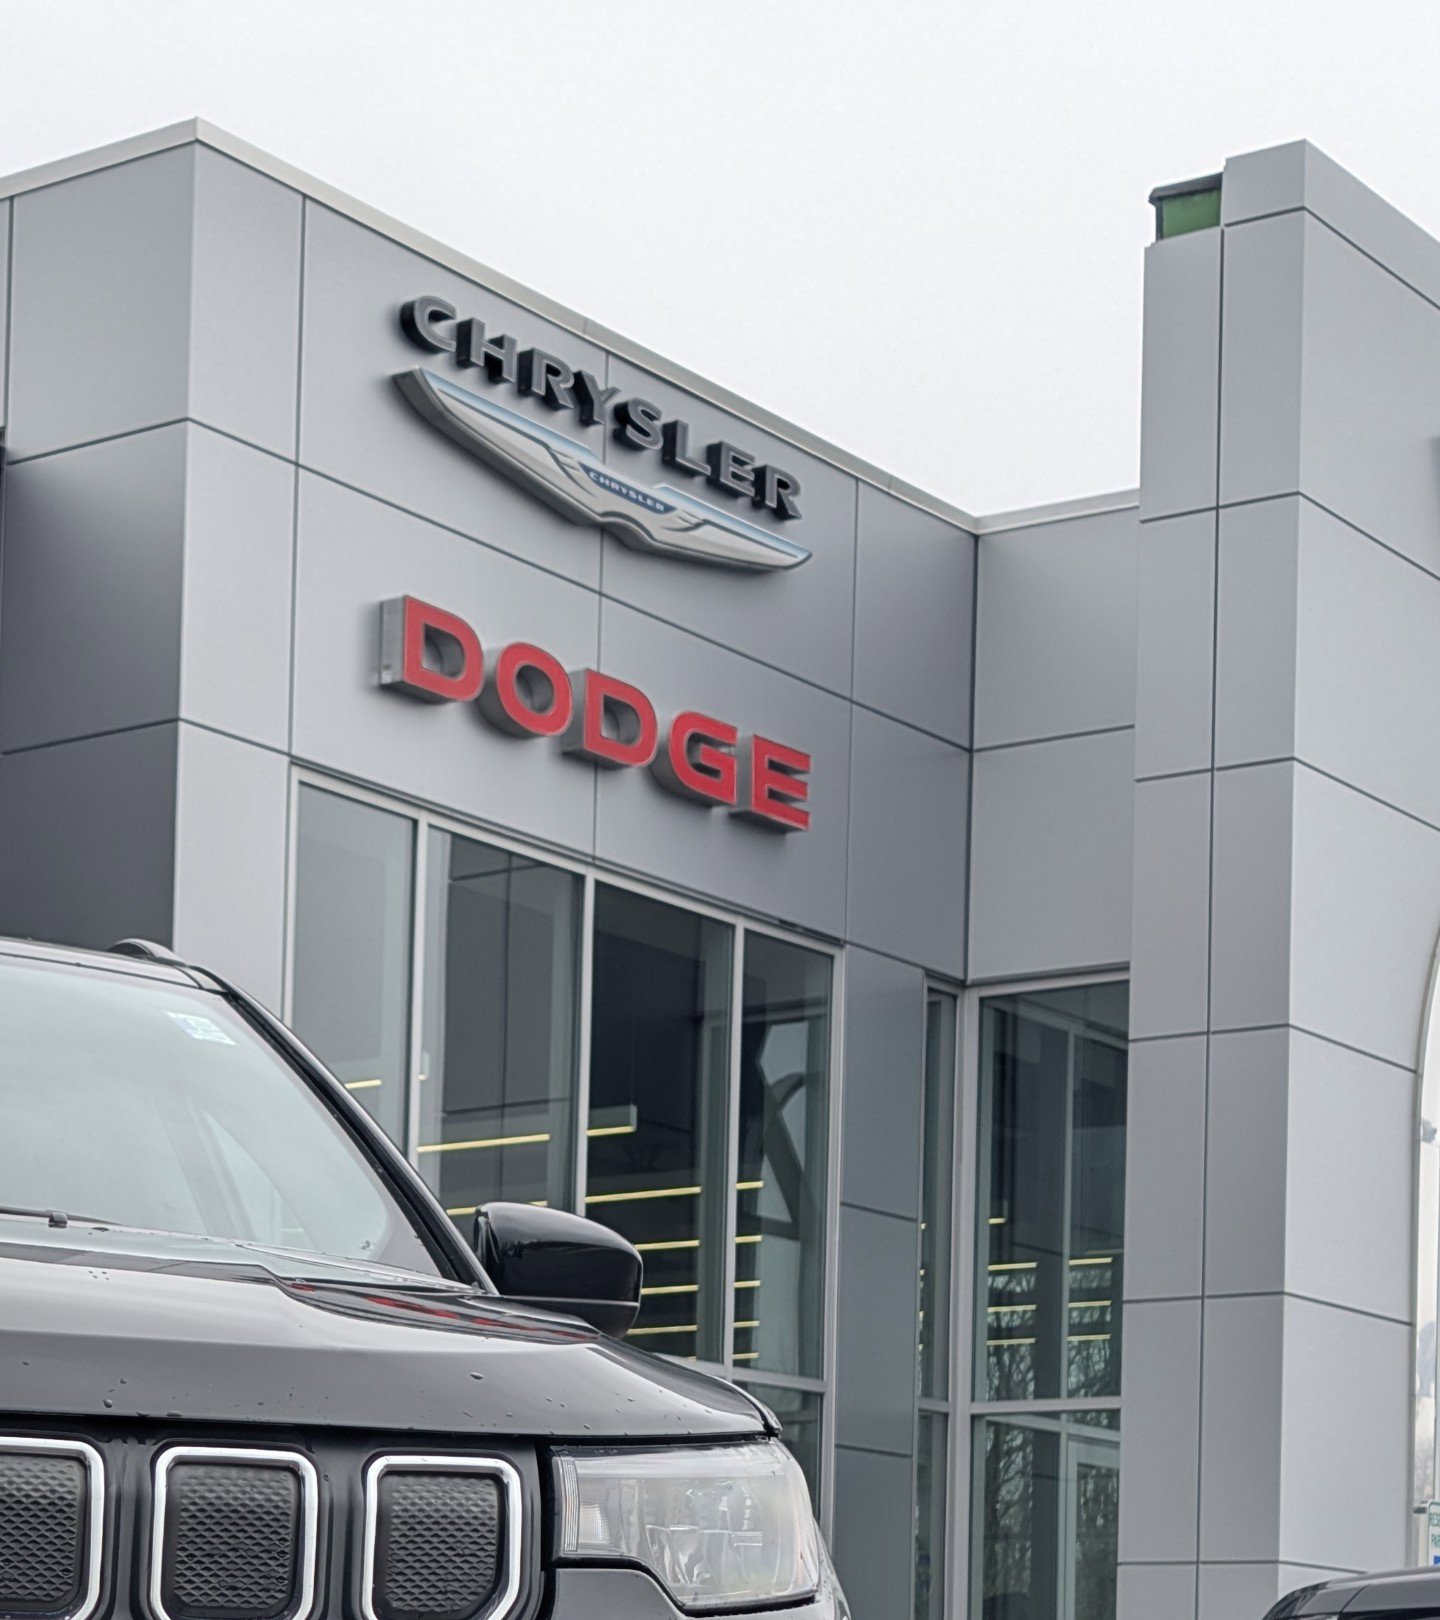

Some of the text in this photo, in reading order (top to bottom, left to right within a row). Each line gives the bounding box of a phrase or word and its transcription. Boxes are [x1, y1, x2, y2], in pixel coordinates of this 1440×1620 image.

[399, 295, 803, 519] CHRYSLER
[589, 471, 665, 512] CHRYSLER
[379, 594, 812, 832] DODGE
